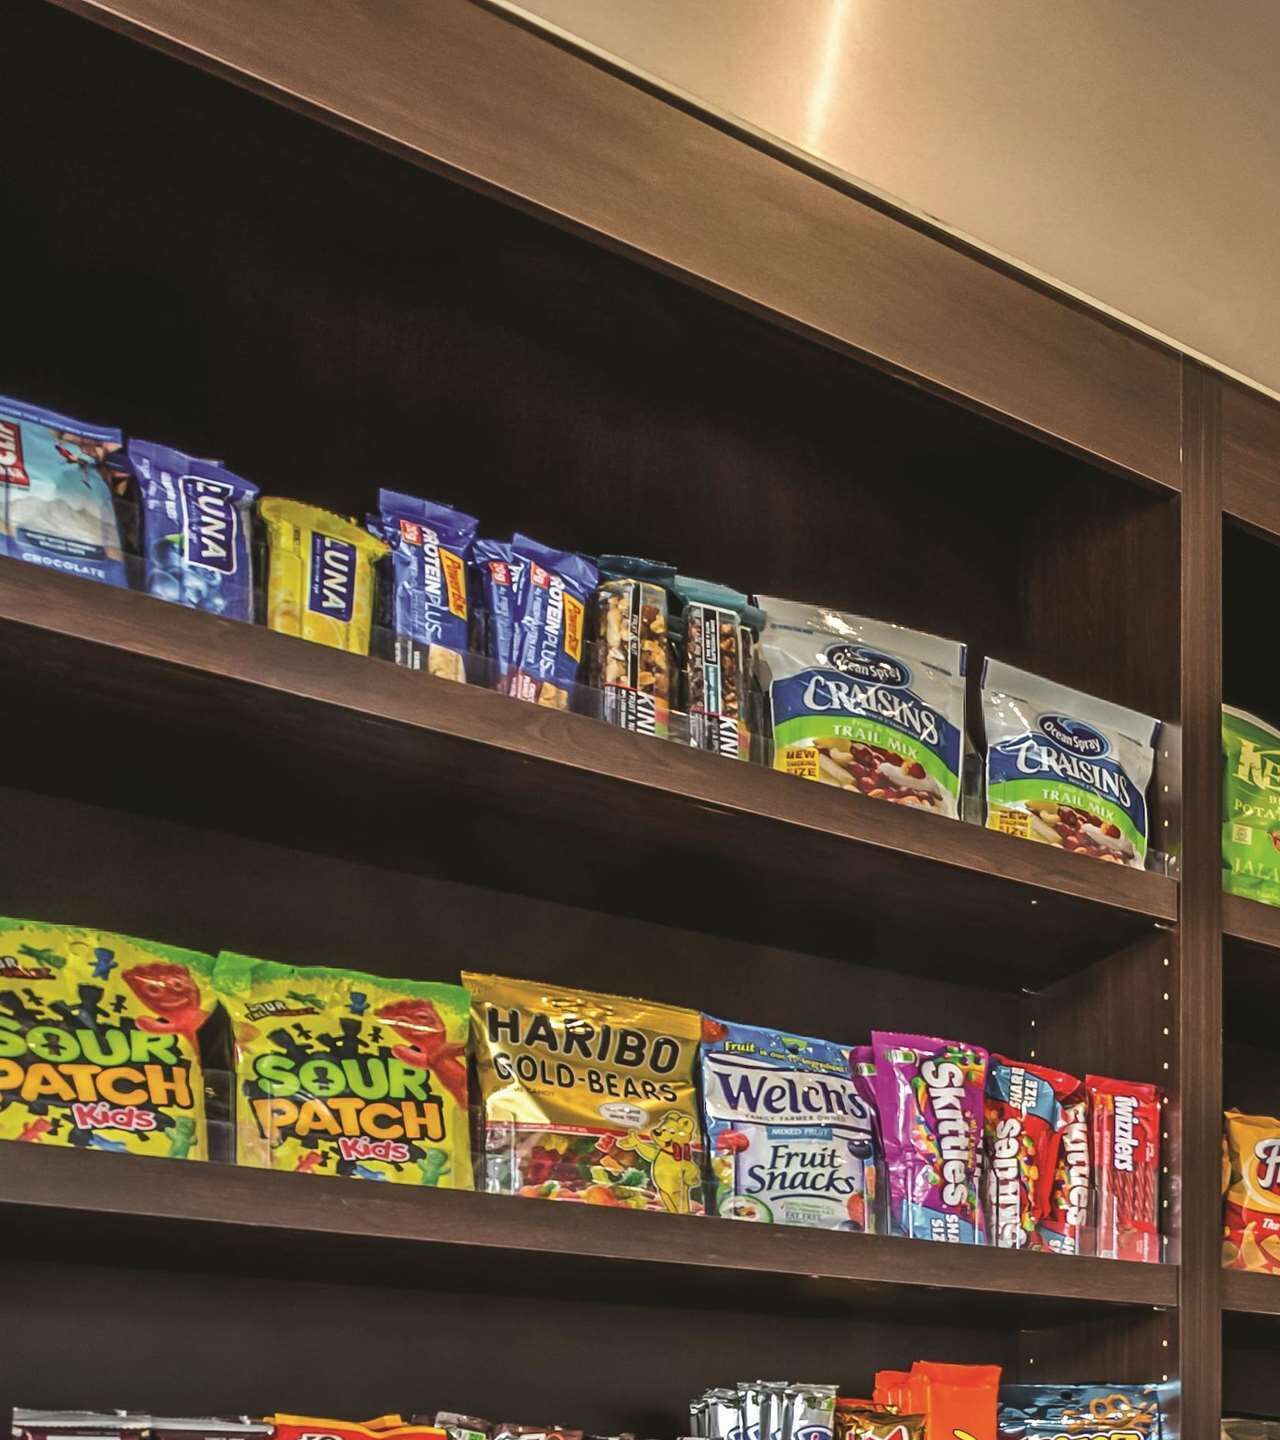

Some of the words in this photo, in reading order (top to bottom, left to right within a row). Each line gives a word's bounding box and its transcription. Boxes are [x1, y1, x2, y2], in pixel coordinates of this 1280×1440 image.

[196, 480, 234, 560] LUNA
[22, 553, 105, 579] CHOCOLATE
[321, 535, 348, 612] LUNA
[803, 675, 940, 746] CRAISINS
[833, 723, 882, 746] TRAIL
[886, 737, 919, 760] MIX
[1044, 721, 1073, 746] Ocean
[1072, 734, 1101, 756] Spray
[1016, 740, 1131, 808] CRAISINS
[1042, 788, 1084, 810] TRAIL
[1088, 800, 1115, 822] MIX
[486, 1007, 680, 1074] HARIBO
[724, 1041, 754, 1052] Fruit
[253, 1054, 430, 1102] SOUR
[493, 1053, 678, 1102] GOLD-BEARS
[712, 1071, 867, 1120] Welch's
[1009, 1067, 1025, 1108] SHARE
[1023, 1080, 1038, 1109] SIZE
[71, 1103, 157, 1132] Kids
[249, 1097, 445, 1141] PATCH
[920, 1060, 969, 1207] Skittles
[1114, 1095, 1138, 1172] Twizzlers
[339, 1137, 411, 1163] Kids
[768, 1145, 841, 1170] Fruit
[746, 1165, 855, 1194] Snacks
[1262, 1217, 1280, 1231] The
